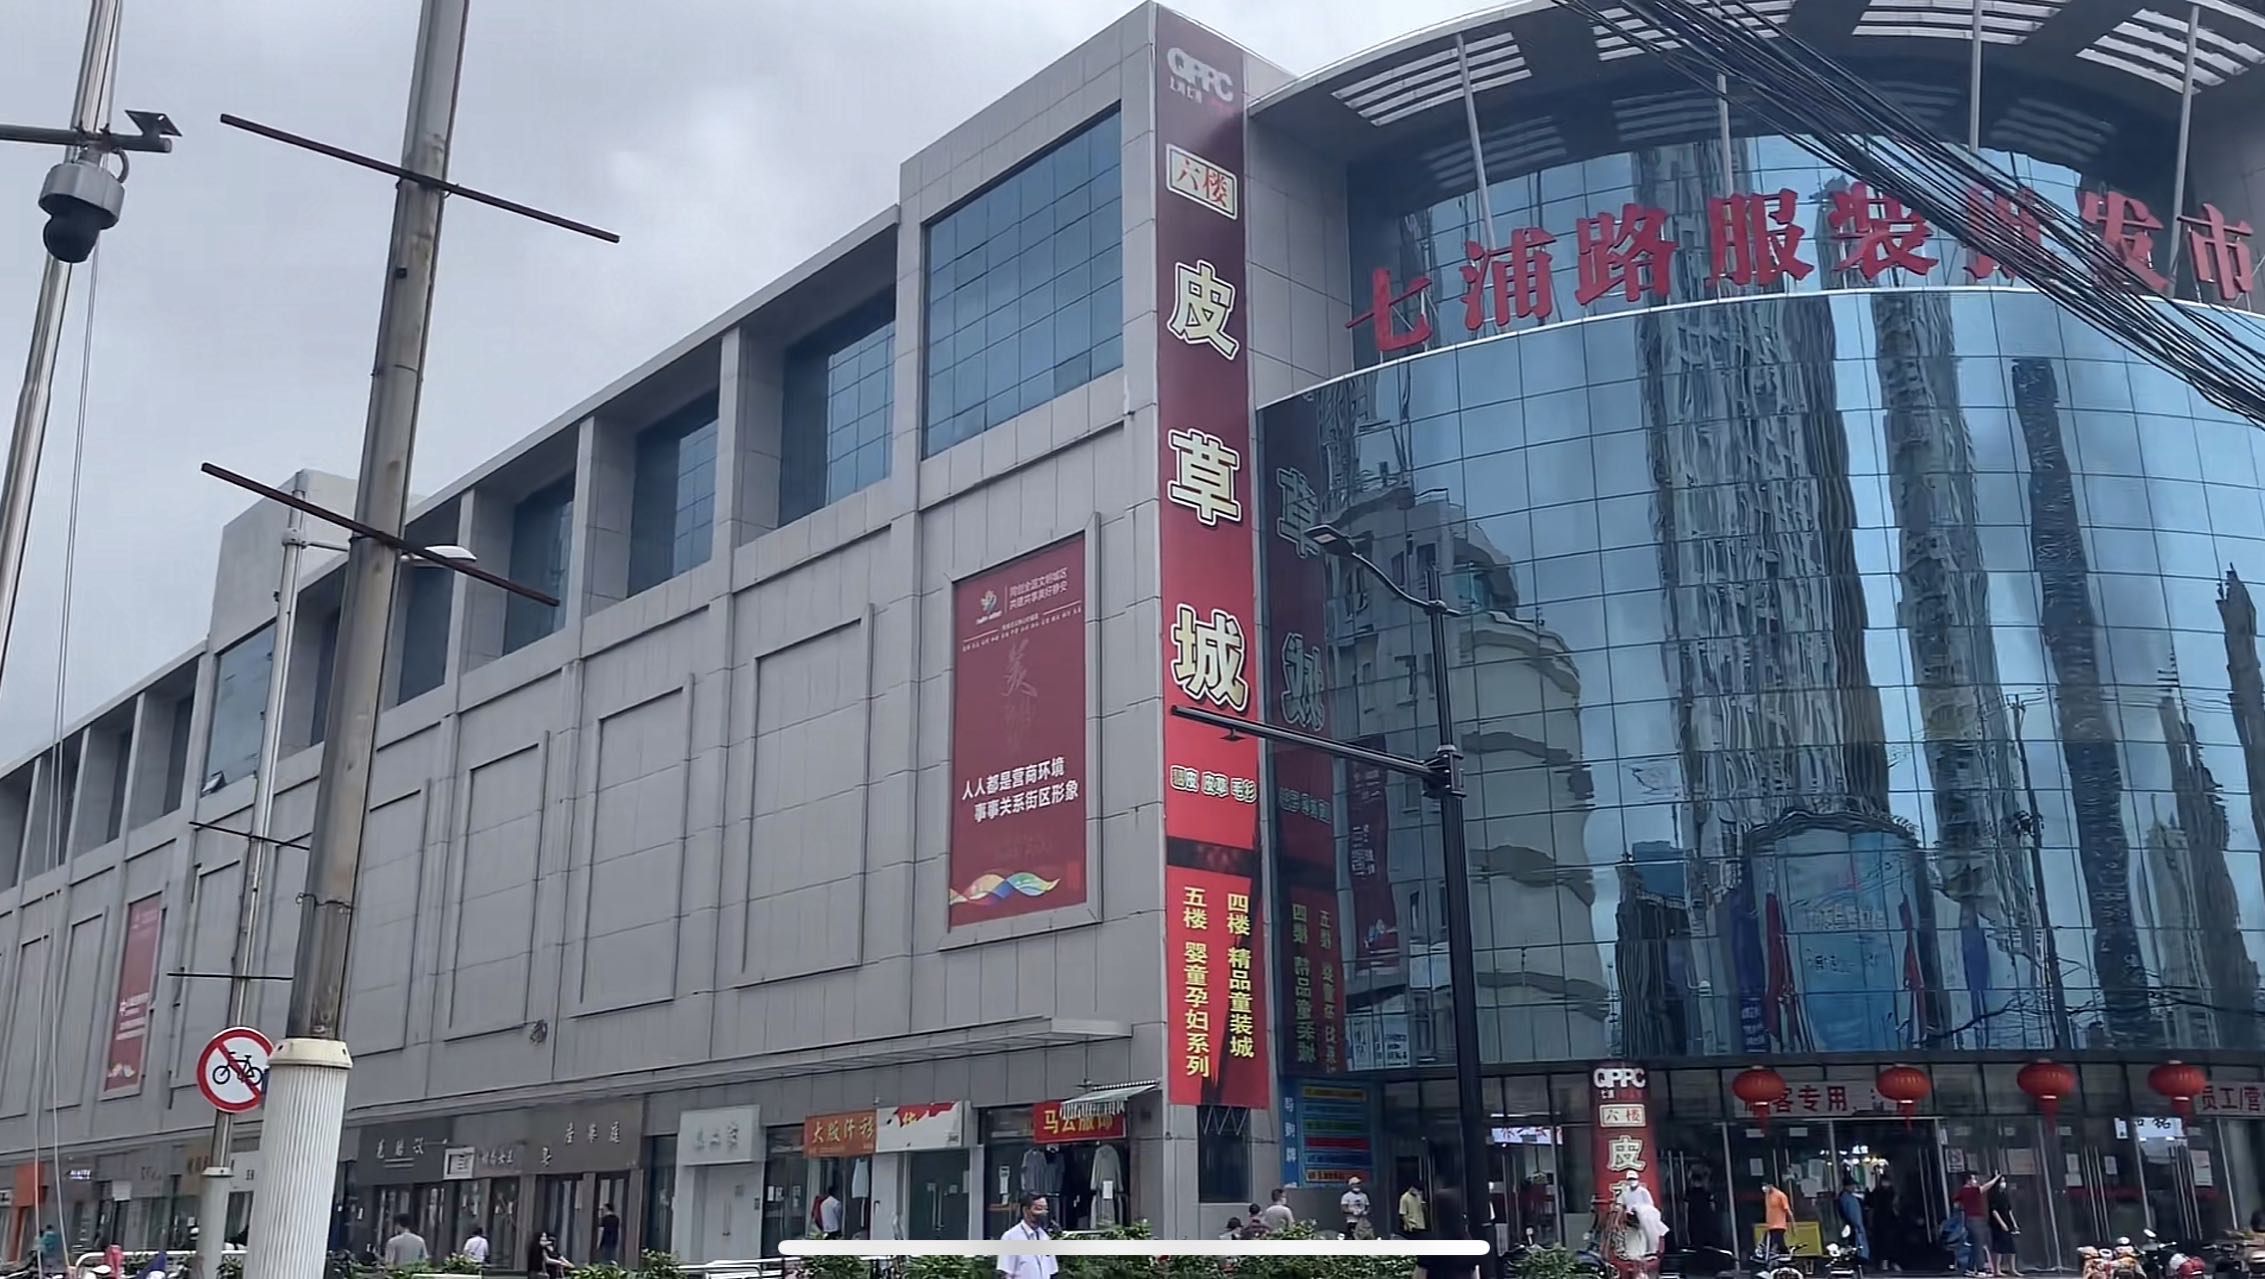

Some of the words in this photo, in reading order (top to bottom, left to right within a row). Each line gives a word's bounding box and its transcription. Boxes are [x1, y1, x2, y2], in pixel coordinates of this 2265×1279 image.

[1176, 158, 1228, 208] 六楼
[1166, 259, 1248, 712] 皮草城
[961, 755, 1065, 801] 人人都是营商环境
[974, 779, 1079, 823] 事事关系街区形象
[1183, 885, 1208, 931] 五楼
[1226, 892, 1250, 936] 四楼
[1183, 941, 1210, 1078] 婴童孕妇系列
[1228, 946, 1254, 1059] 精品童装城
[1593, 1067, 1646, 1088] QPPC
[1744, 1086, 1848, 1113] 客专用
[2202, 1084, 2265, 1112] 员工/营
[1606, 1109, 1641, 1122] 六楼
